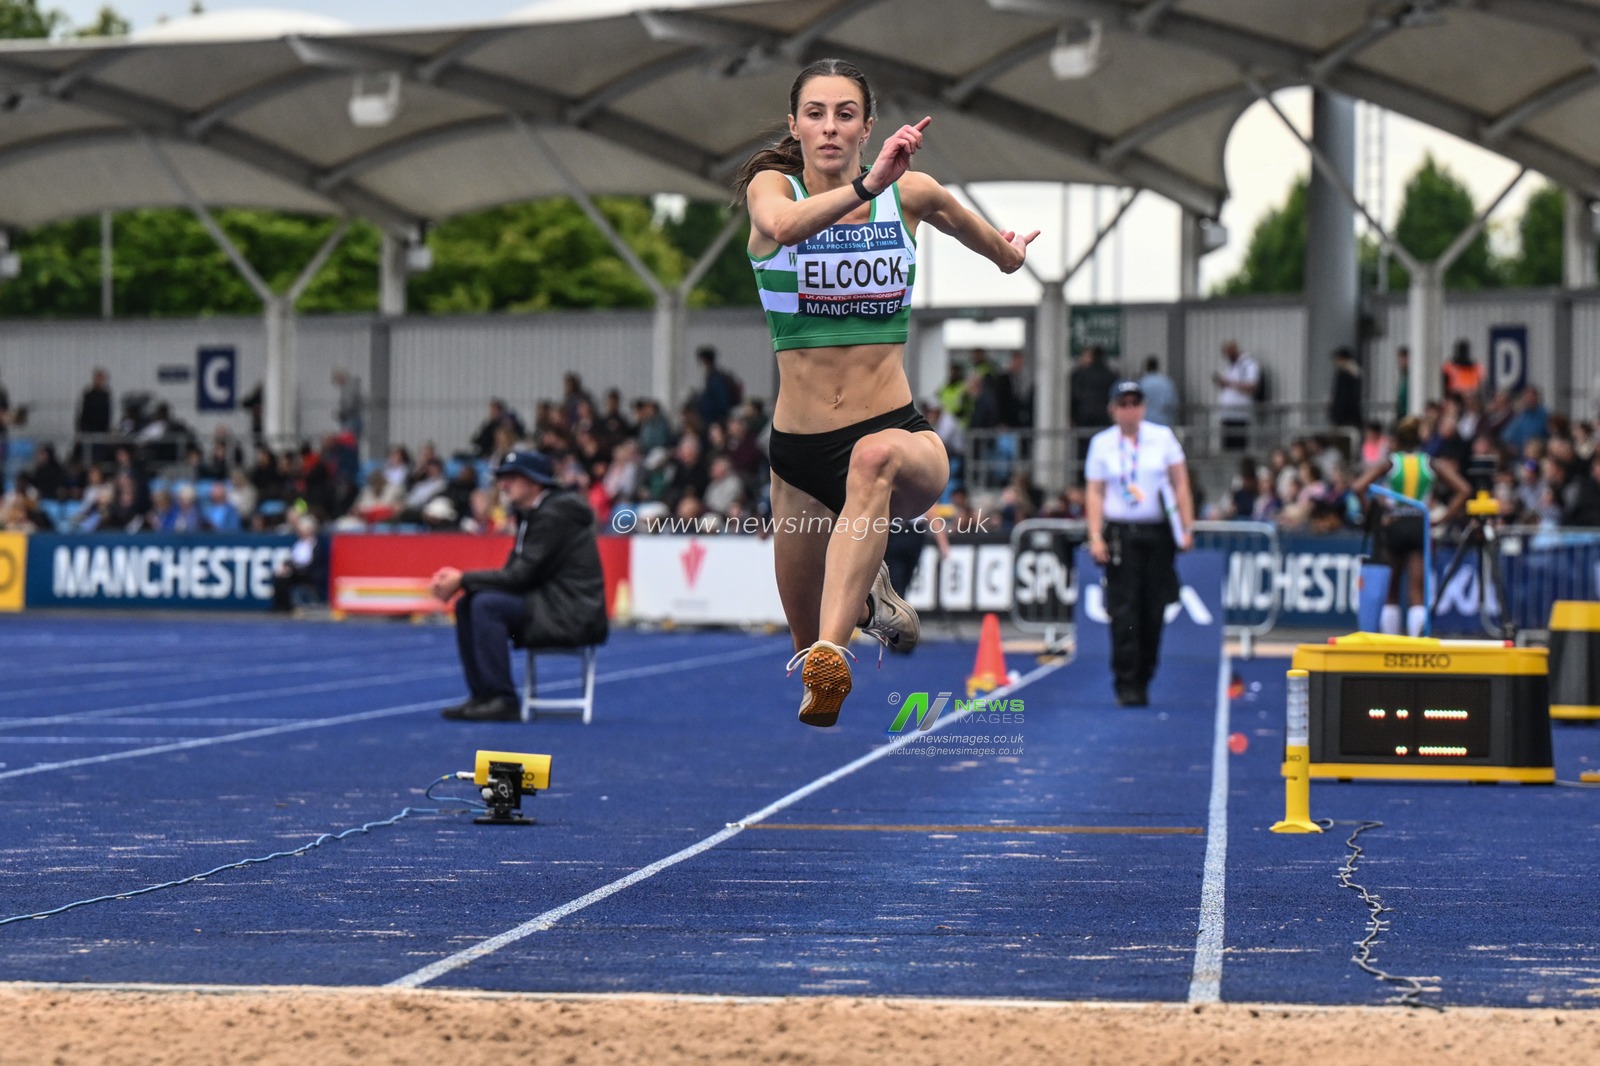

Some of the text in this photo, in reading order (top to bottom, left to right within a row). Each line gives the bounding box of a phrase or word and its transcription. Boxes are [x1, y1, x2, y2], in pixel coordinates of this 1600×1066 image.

[826, 242, 867, 250] PROCESSING
[804, 256, 904, 289] ELCOCK
[852, 291, 902, 299] CHAMPIONSHIPS
[806, 300, 900, 315] MANCHESTER
[1495, 338, 1522, 390] D
[204, 355, 231, 403] C
[1384, 653, 1451, 669] SEIKO
